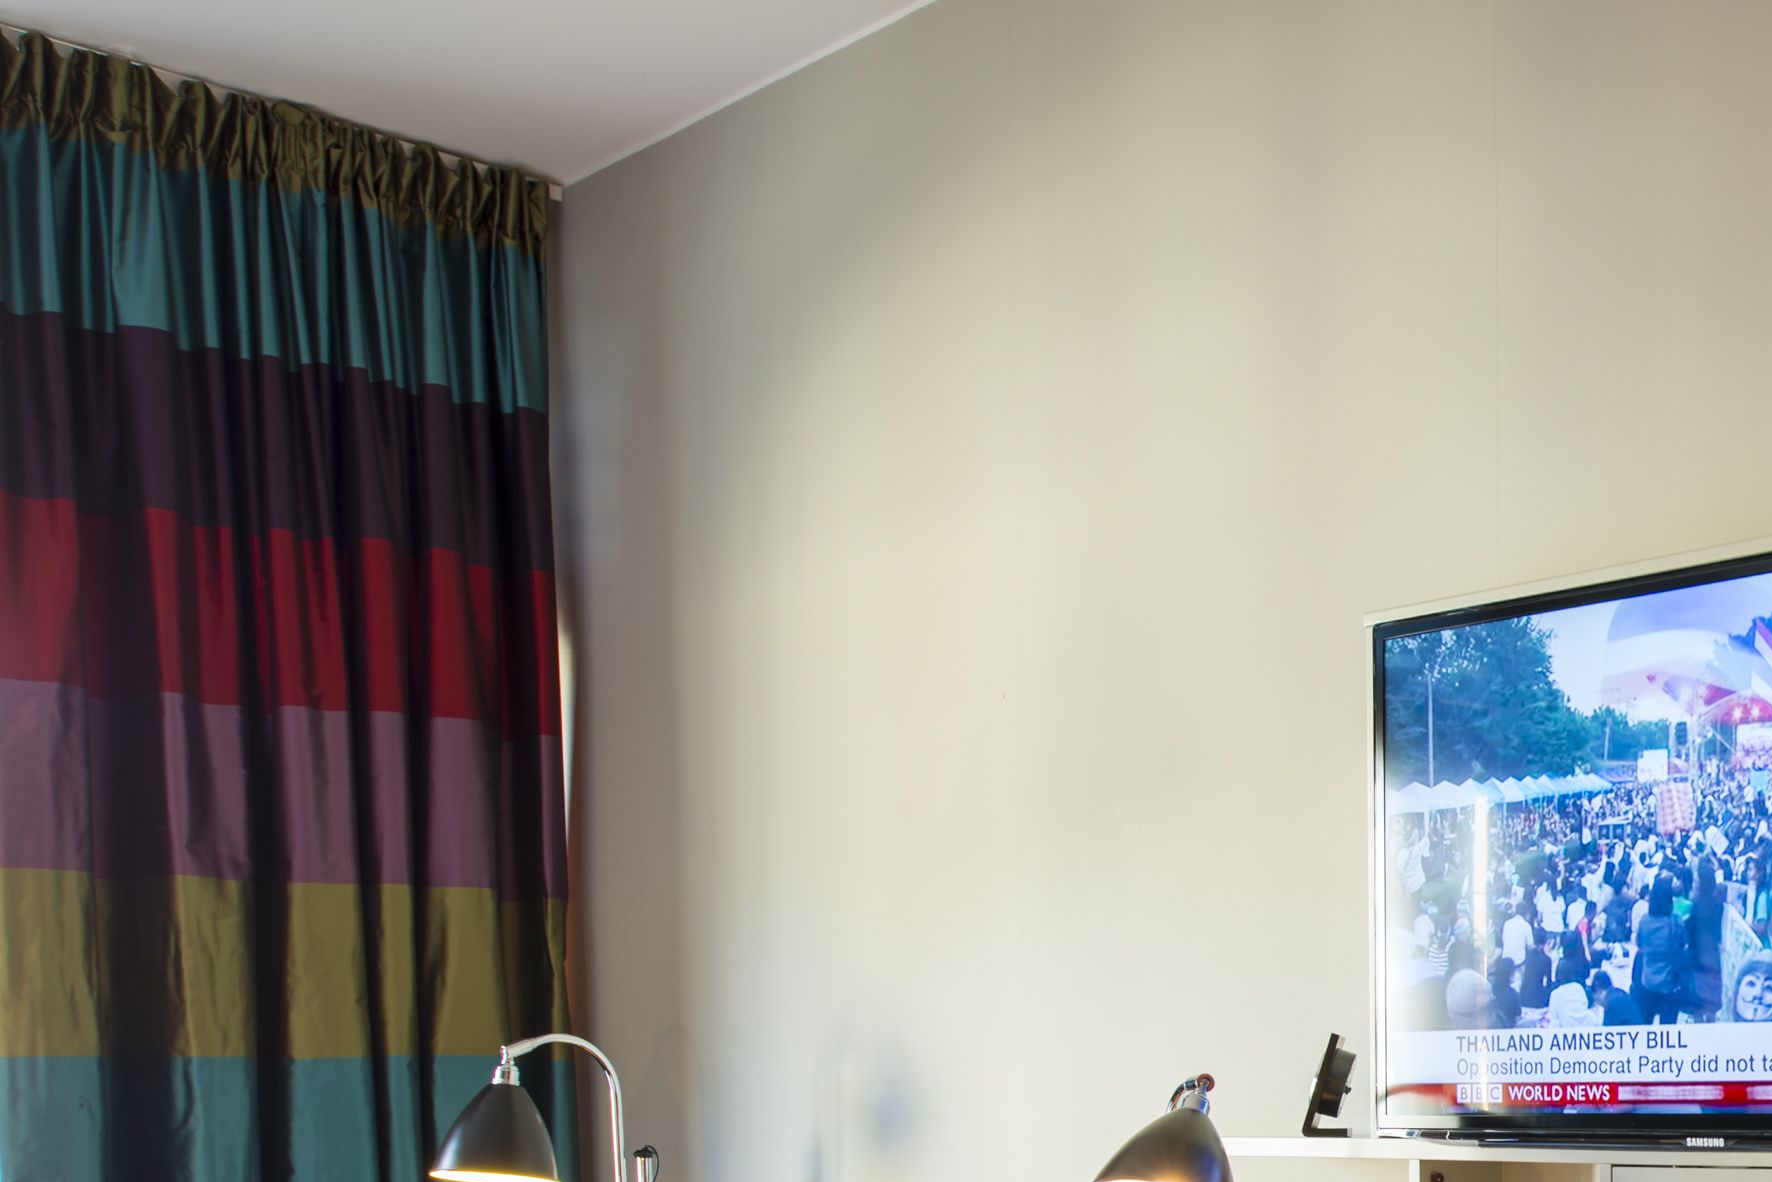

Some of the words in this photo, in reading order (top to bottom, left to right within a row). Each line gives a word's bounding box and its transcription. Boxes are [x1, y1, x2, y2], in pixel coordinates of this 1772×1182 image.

[1456, 1033, 1544, 1053] THAILAND
[1549, 1031, 1640, 1051] AMNESTY
[1646, 1030, 1688, 1049] BILL
[1457, 1057, 1544, 1080] Oposition
[1550, 1056, 1632, 1075] Democrat
[1639, 1055, 1684, 1078] Party
[1691, 1054, 1719, 1073] did
[1726, 1054, 1756, 1073] not
[1508, 1085, 1563, 1102] WORLD
[1566, 1084, 1611, 1101] NEWS
[1686, 1137, 1725, 1148] SAMSUNG
